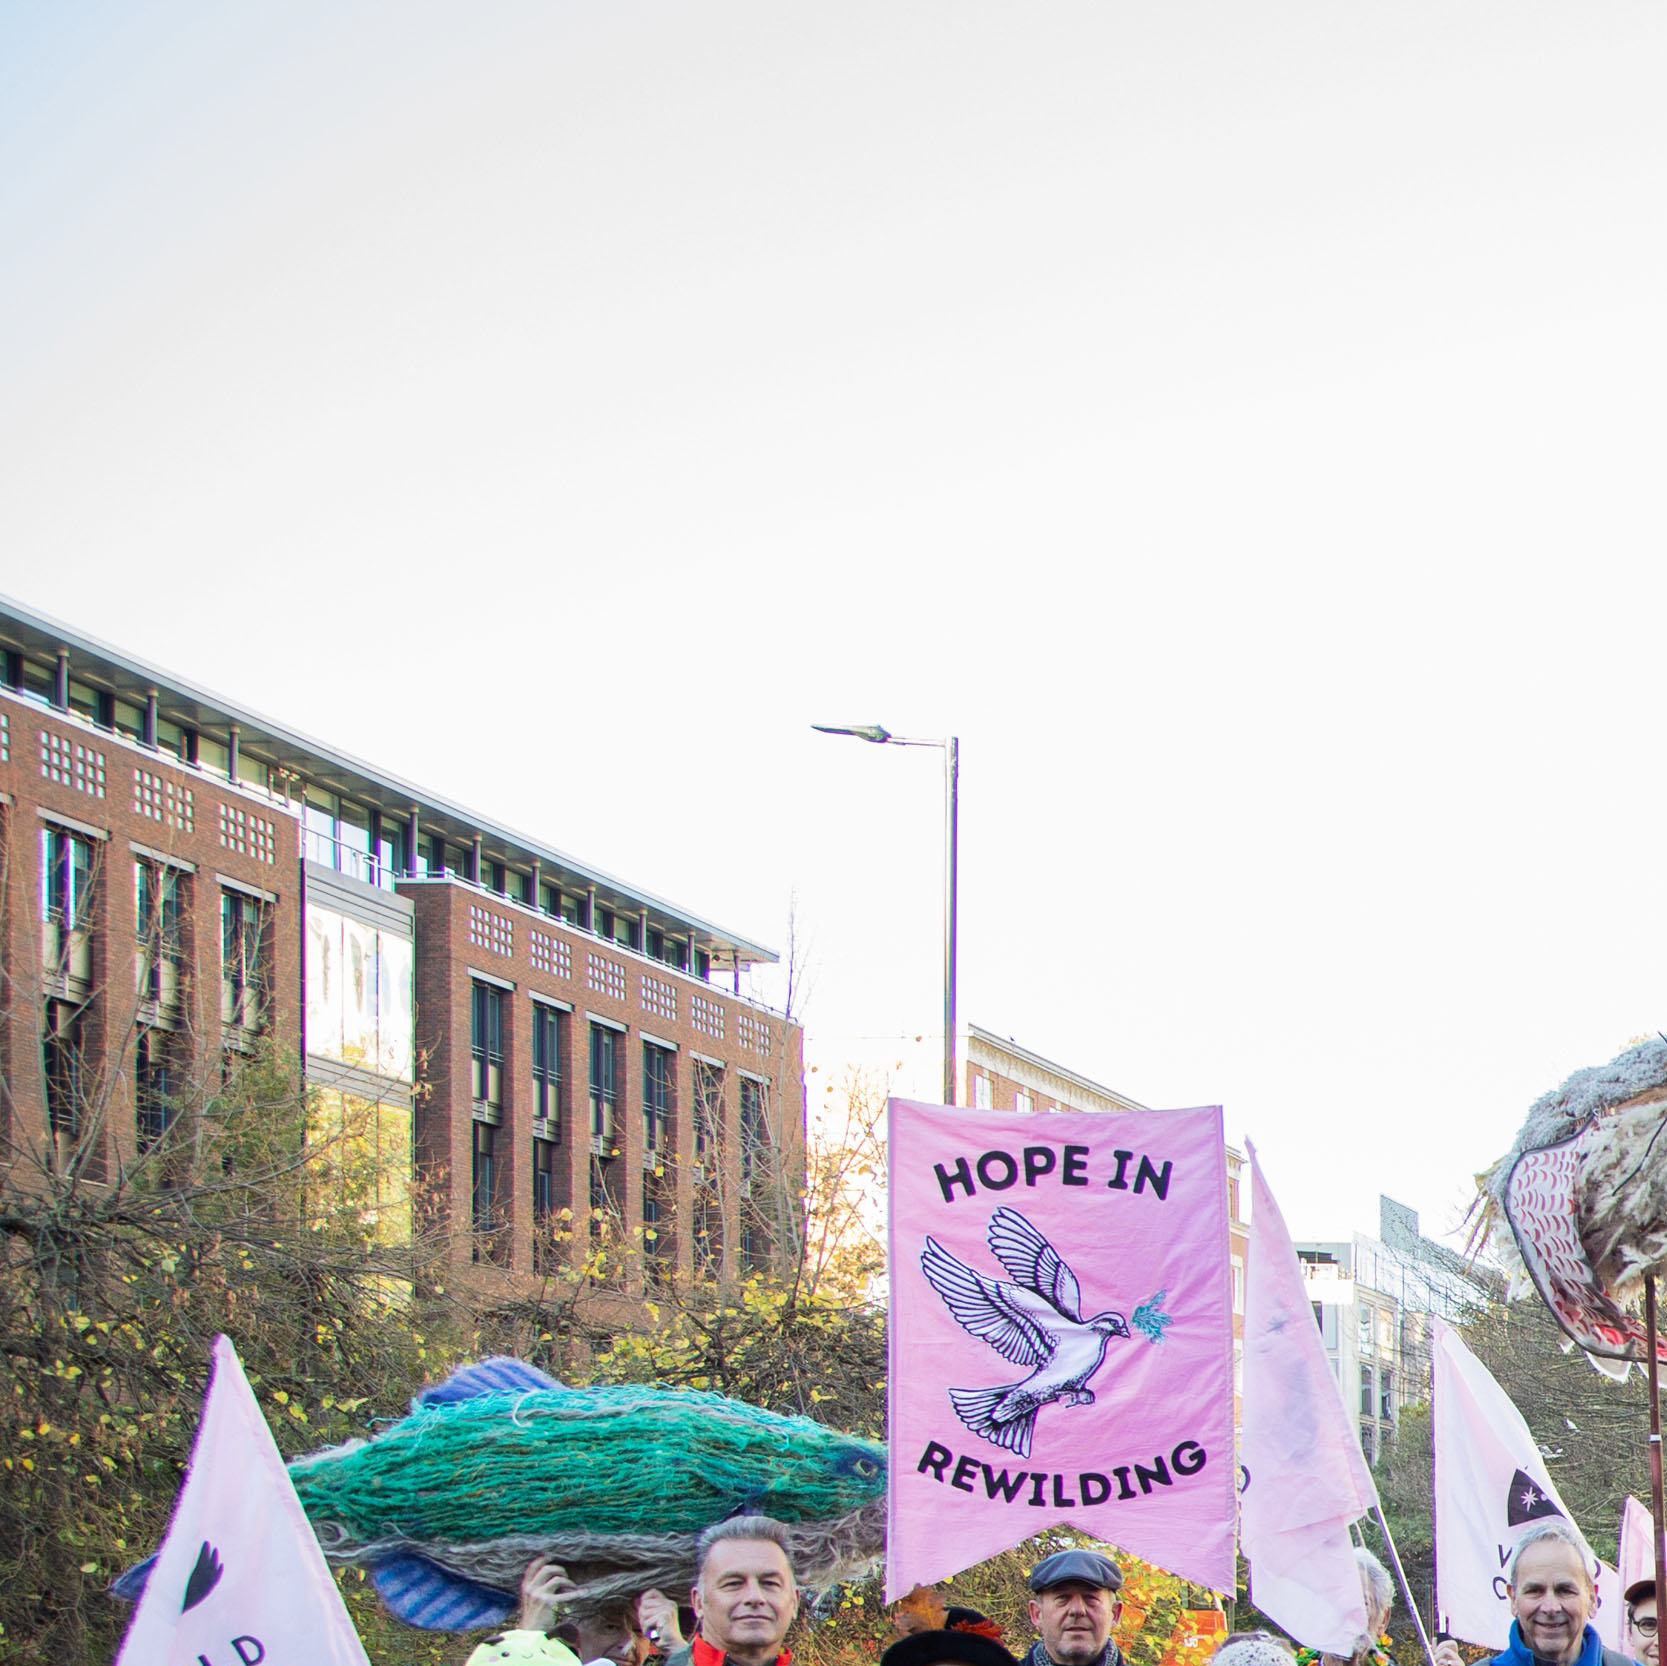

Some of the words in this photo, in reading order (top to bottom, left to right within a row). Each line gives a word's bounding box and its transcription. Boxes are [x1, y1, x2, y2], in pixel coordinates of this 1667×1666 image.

[934, 1146, 1089, 1202] HOPE
[1108, 1149, 1172, 1200] IN
[918, 1440, 1207, 1508] REWILDING
